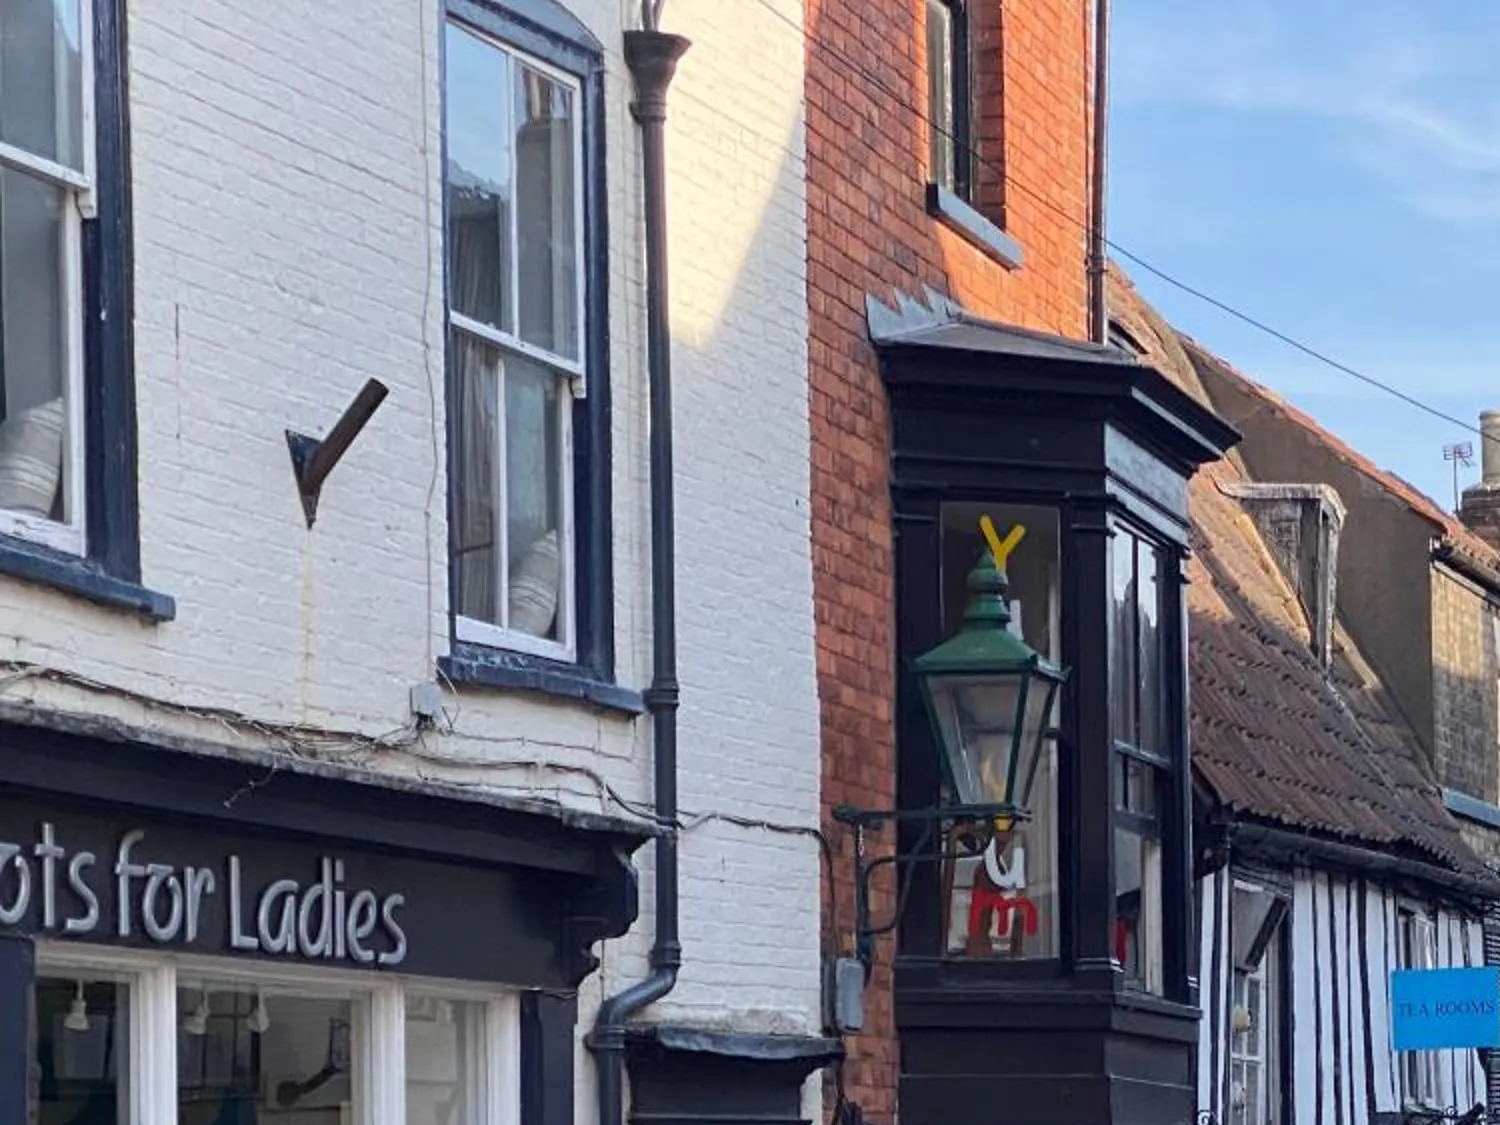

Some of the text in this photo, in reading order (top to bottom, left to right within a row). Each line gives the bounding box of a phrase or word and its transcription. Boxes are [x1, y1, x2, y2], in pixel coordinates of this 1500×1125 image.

[116, 829, 215, 942] for
[229, 855, 407, 964] Ladies
[1400, 1001, 1495, 1018] TEA ROOMS
